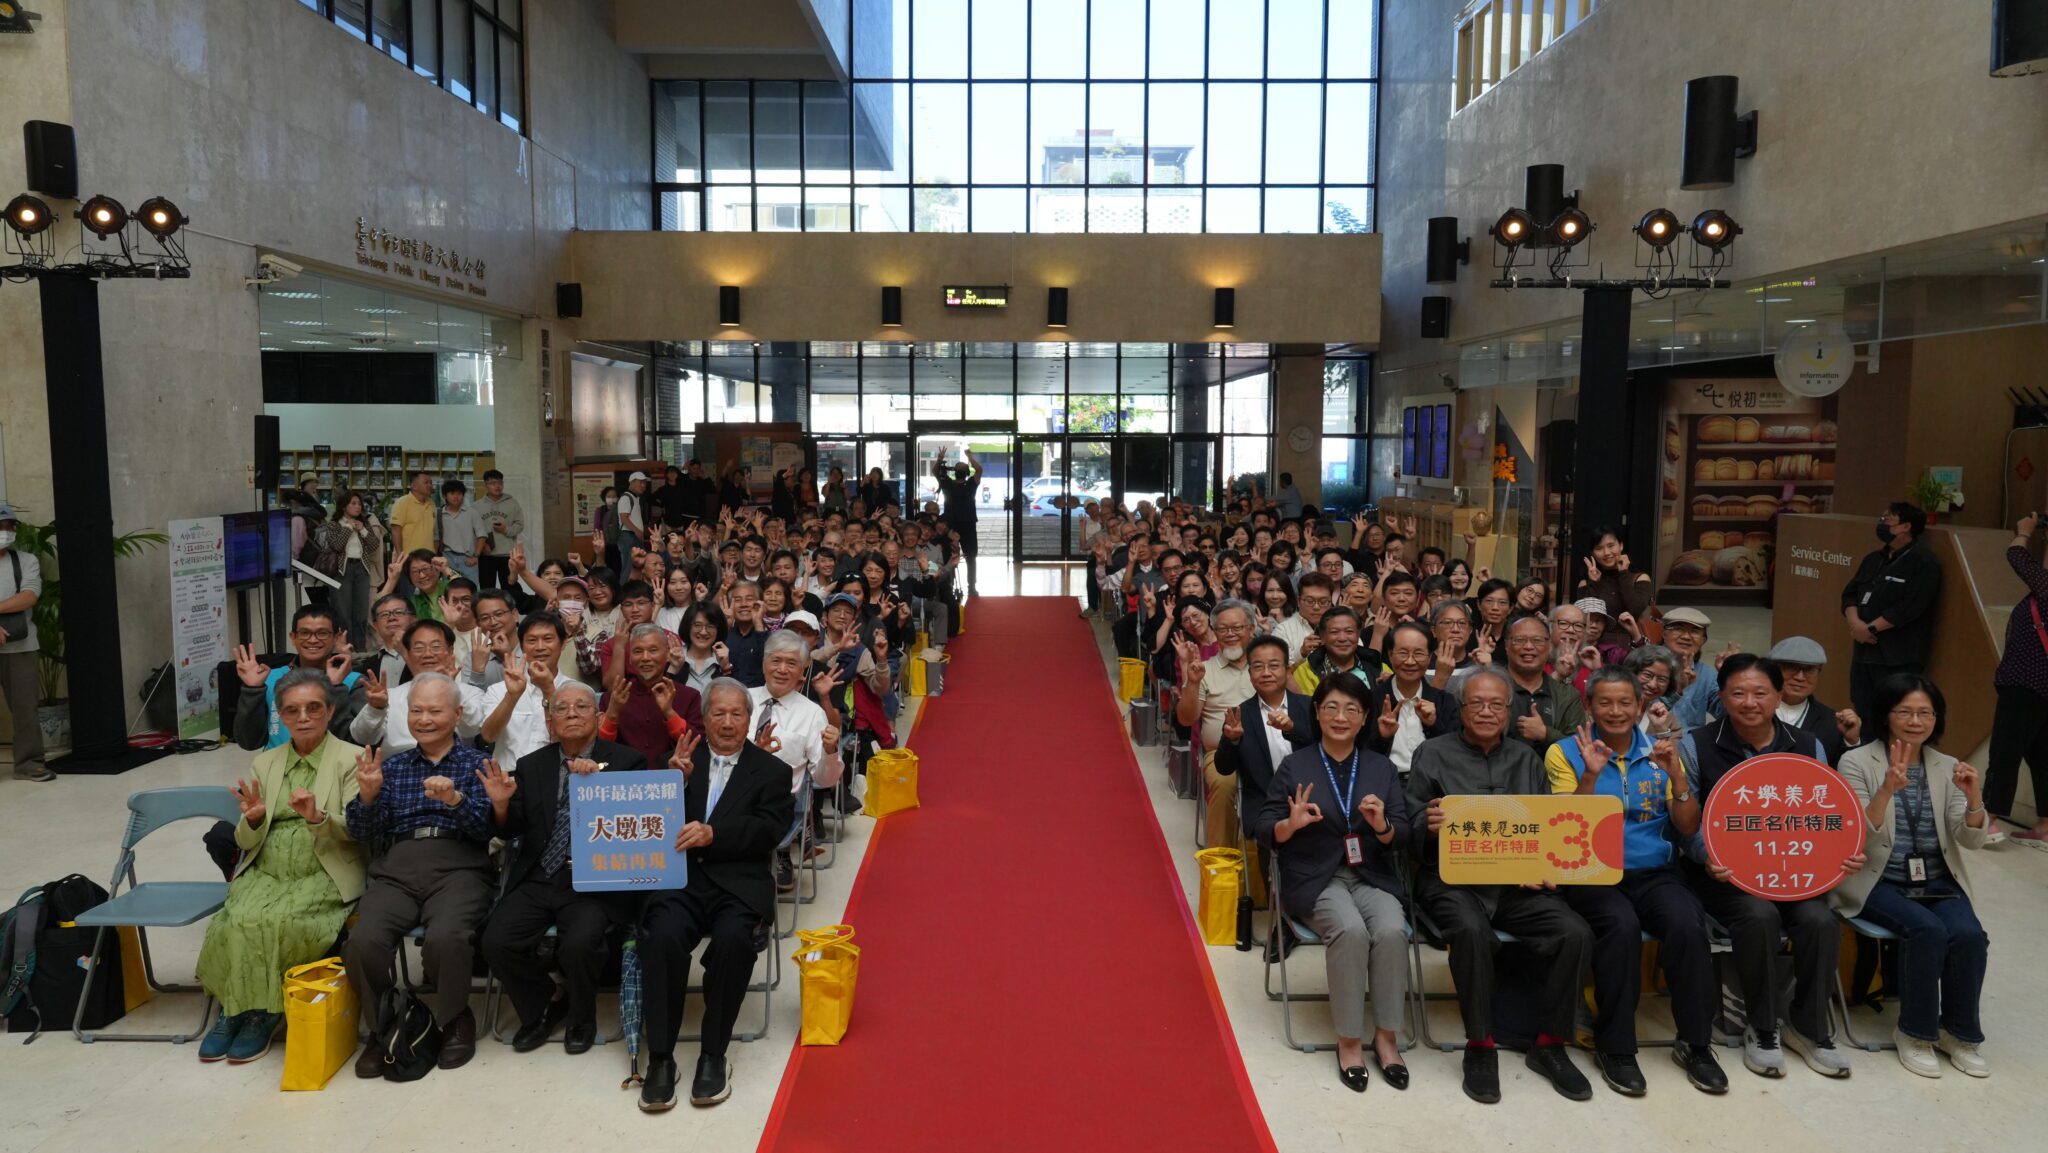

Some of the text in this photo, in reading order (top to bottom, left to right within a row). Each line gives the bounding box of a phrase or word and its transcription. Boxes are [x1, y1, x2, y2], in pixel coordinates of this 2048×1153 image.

[1791, 545, 1852, 566] Service Center
[577, 782, 678, 802] 30年最高榮耀
[588, 813, 665, 843] 大墩獎
[1724, 813, 1844, 832] 巨匠名作特展
[1448, 839, 1540, 854] 巨匠名作特展
[1754, 840, 1814, 856] 11.29
[1755, 873, 1815, 888] 12.17
